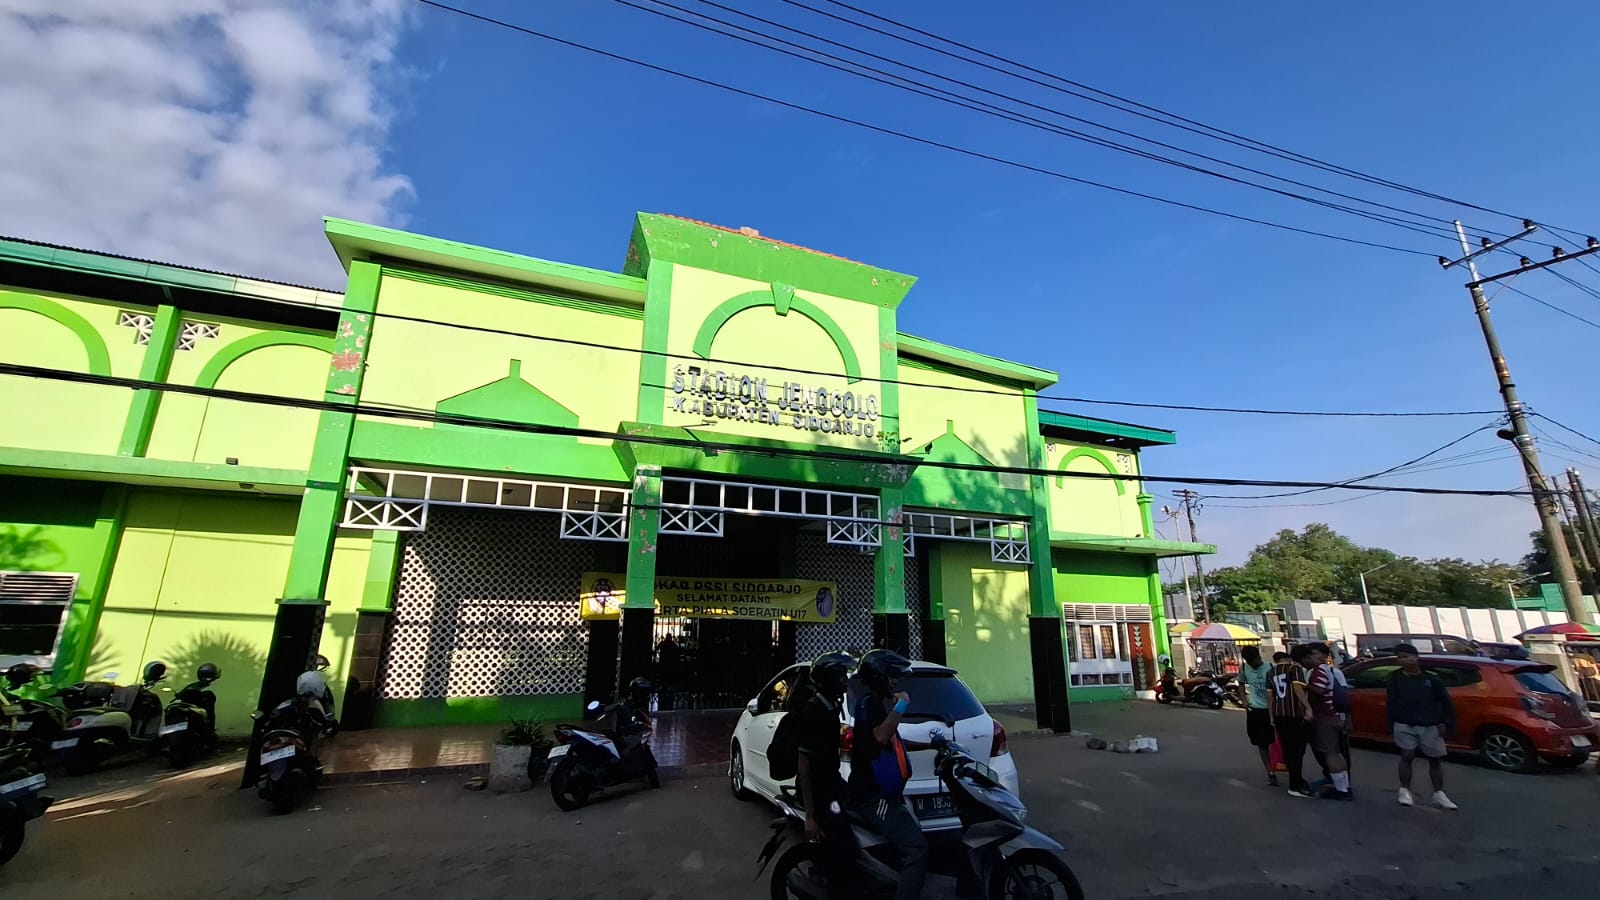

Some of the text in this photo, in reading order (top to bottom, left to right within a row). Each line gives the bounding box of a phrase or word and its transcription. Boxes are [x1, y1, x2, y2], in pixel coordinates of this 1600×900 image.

[672, 363, 878, 421] STADION JENGGOLO
[672, 396, 875, 438] KABUPATEN SIDOARJO
[655, 580, 801, 594] KAB PSSI SIDOARJO
[677, 593, 771, 604] SELAMAT DATANG
[692, 605, 729, 616] PIALA
[732, 606, 787, 617] SOERATIN
[790, 609, 807, 619] U17
[1273, 673, 1287, 699] 15
